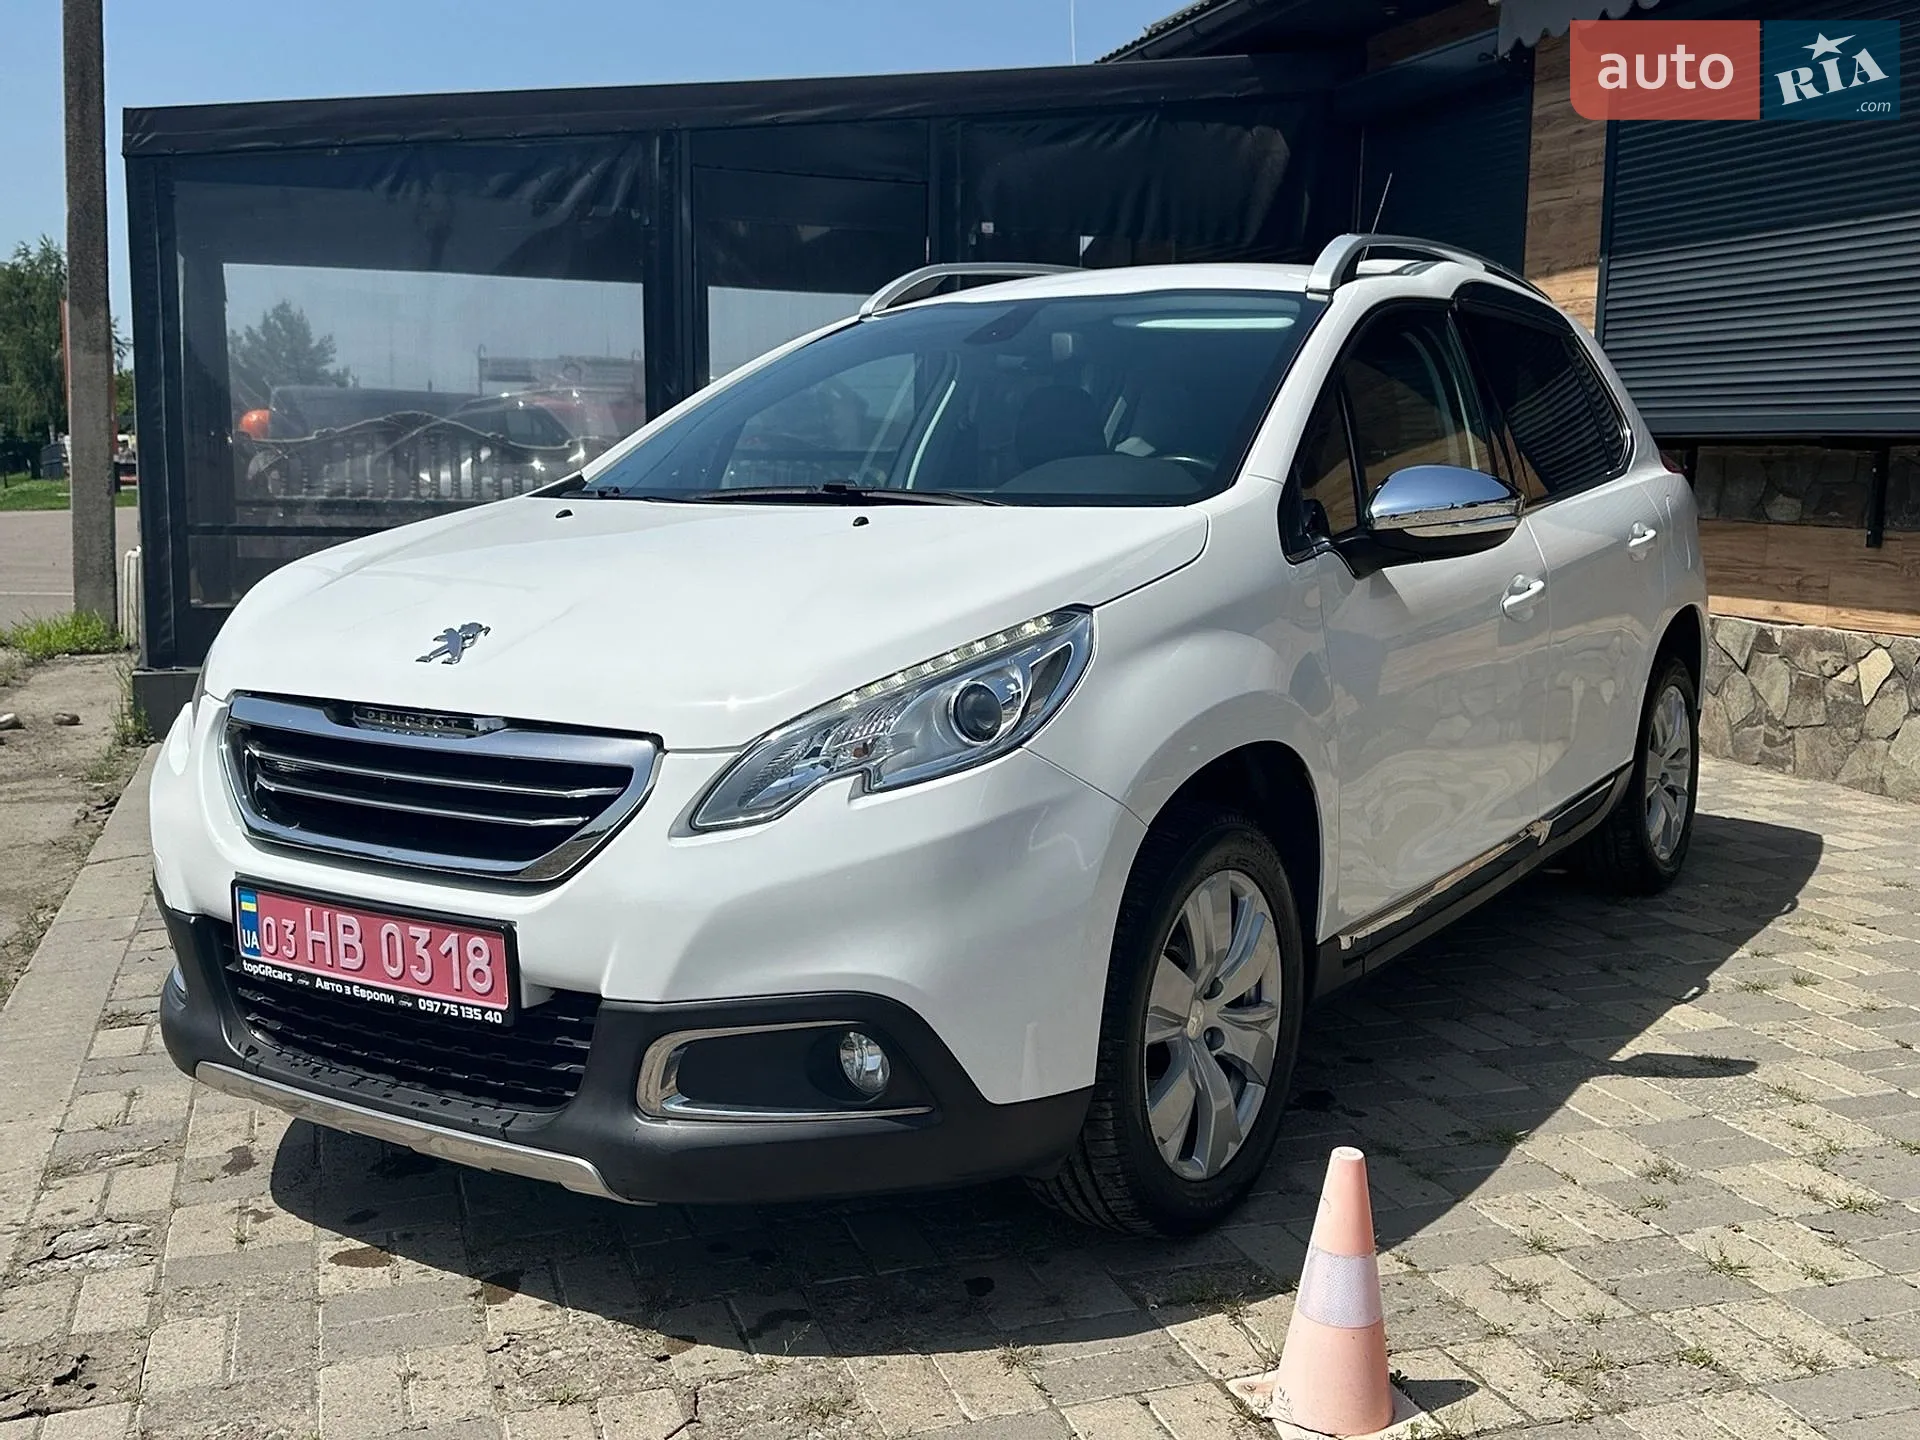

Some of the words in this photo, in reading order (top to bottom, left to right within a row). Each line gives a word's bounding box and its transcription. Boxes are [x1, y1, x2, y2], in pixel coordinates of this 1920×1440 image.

[242, 929, 260, 950] UA
[262, 916, 297, 959] 03
[380, 922, 495, 994] 0318
[243, 960, 294, 983] topGRcars
[315, 977, 343, 994] Авто
[352, 985, 395, 1005] Європи
